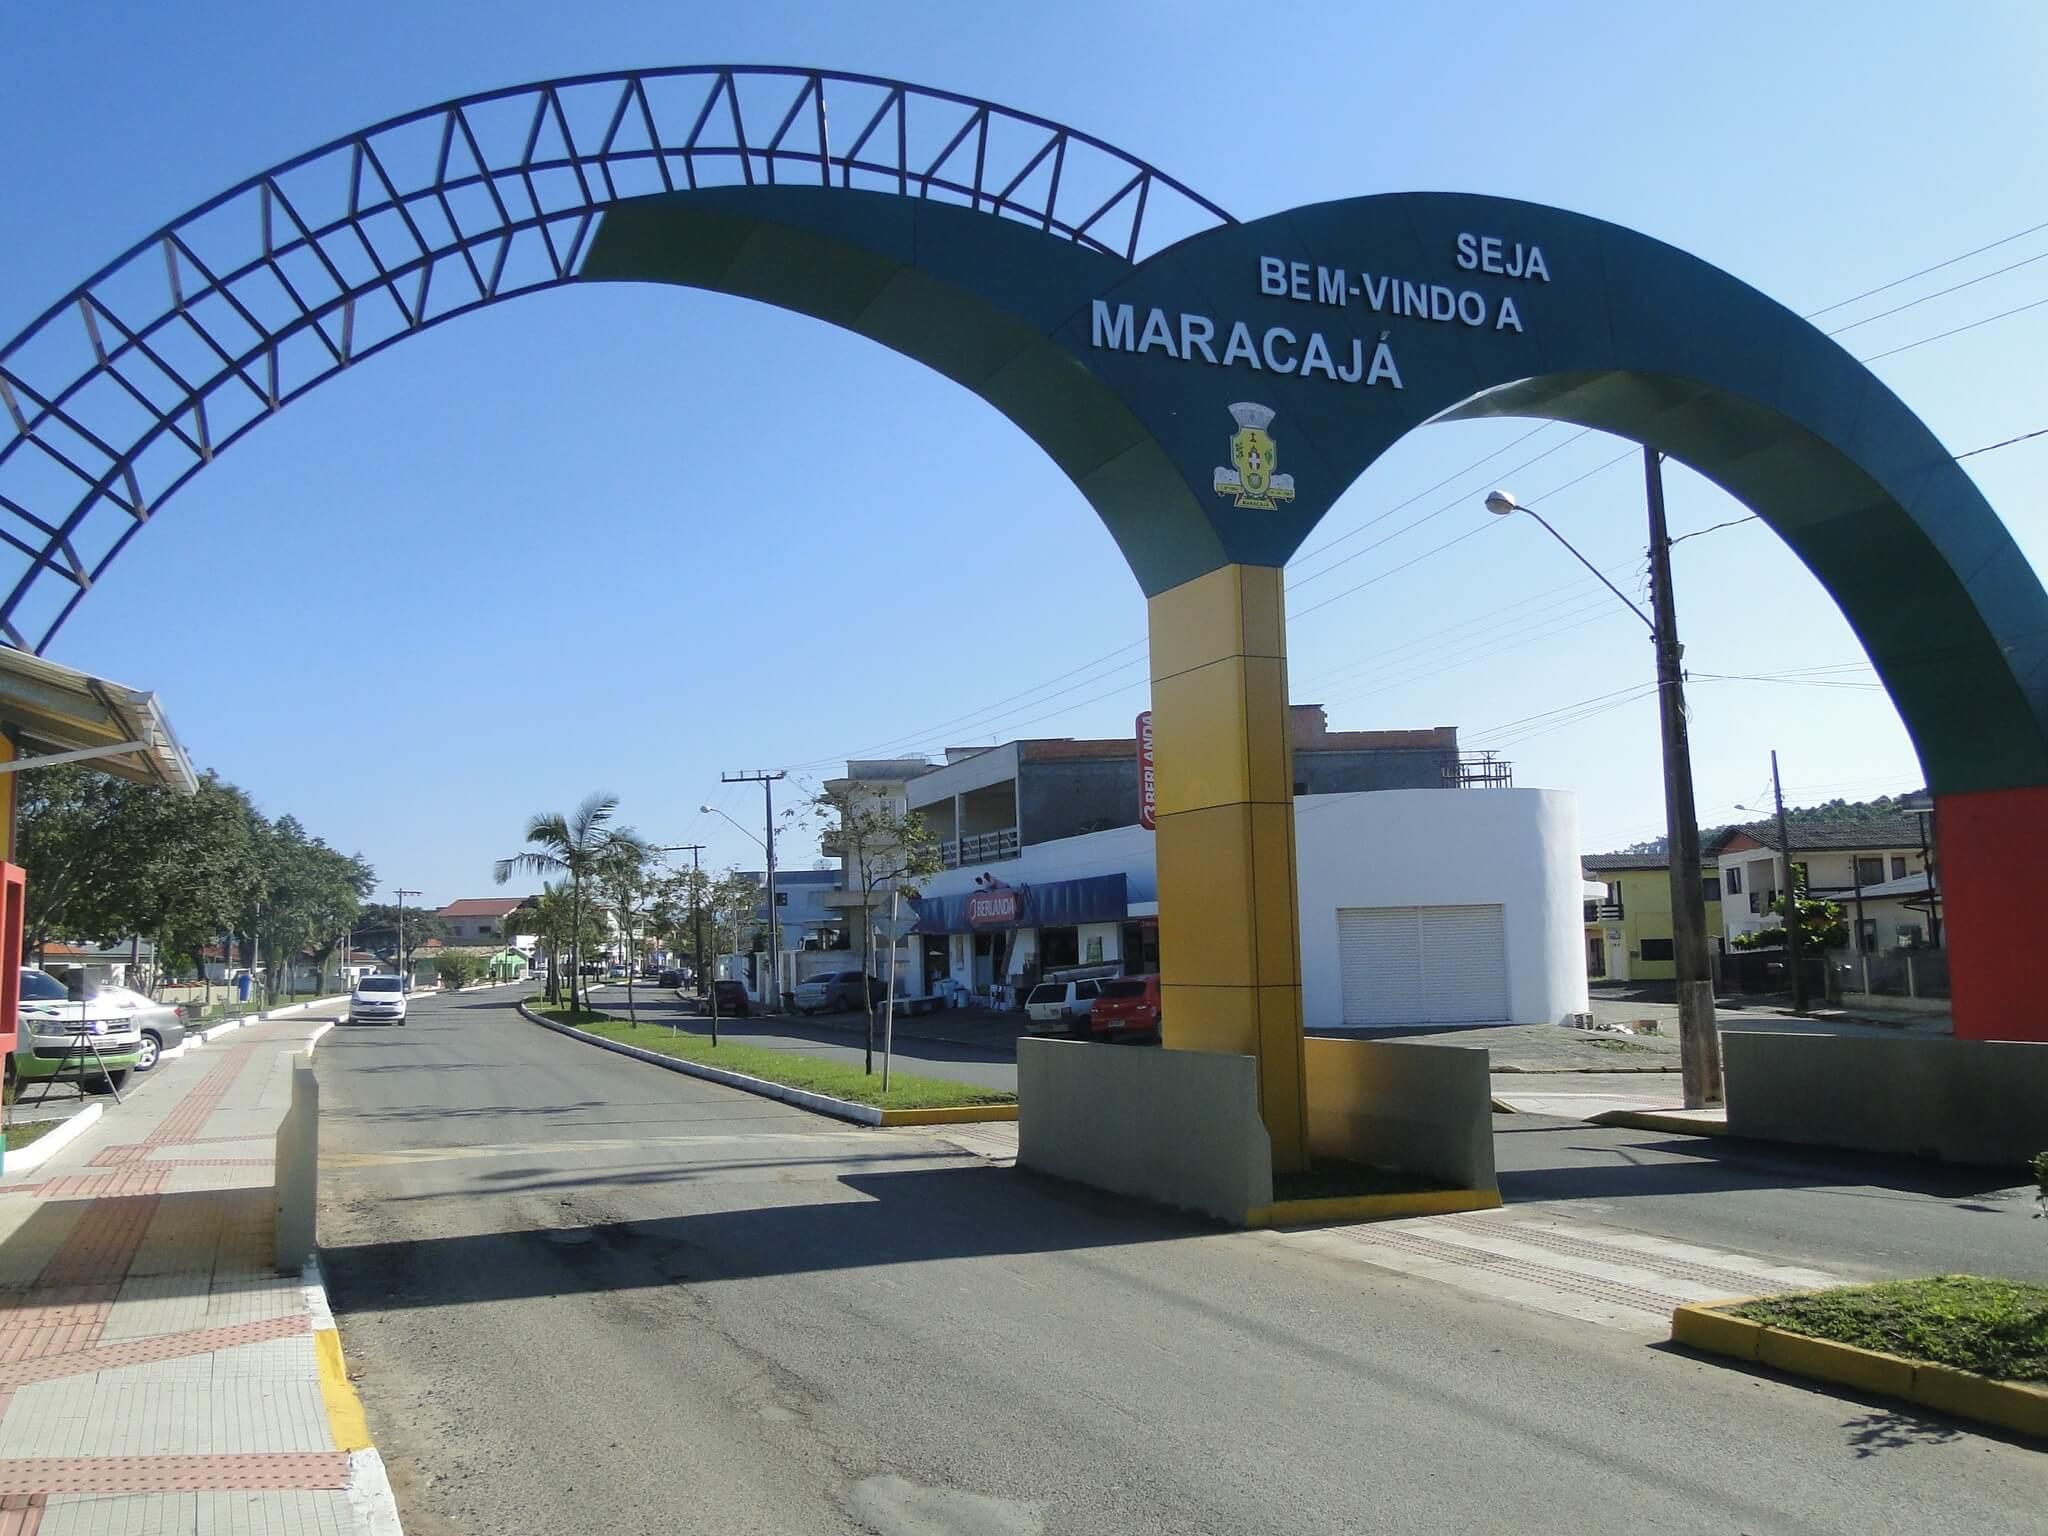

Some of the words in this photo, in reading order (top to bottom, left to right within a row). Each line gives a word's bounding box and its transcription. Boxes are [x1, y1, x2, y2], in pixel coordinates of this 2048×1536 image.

[1260, 256, 1486, 327] BEM-VINDO
[1496, 297, 1524, 333] A
[1456, 232, 1551, 282] SEJA
[1091, 299, 1403, 389] MARACAJÁ
